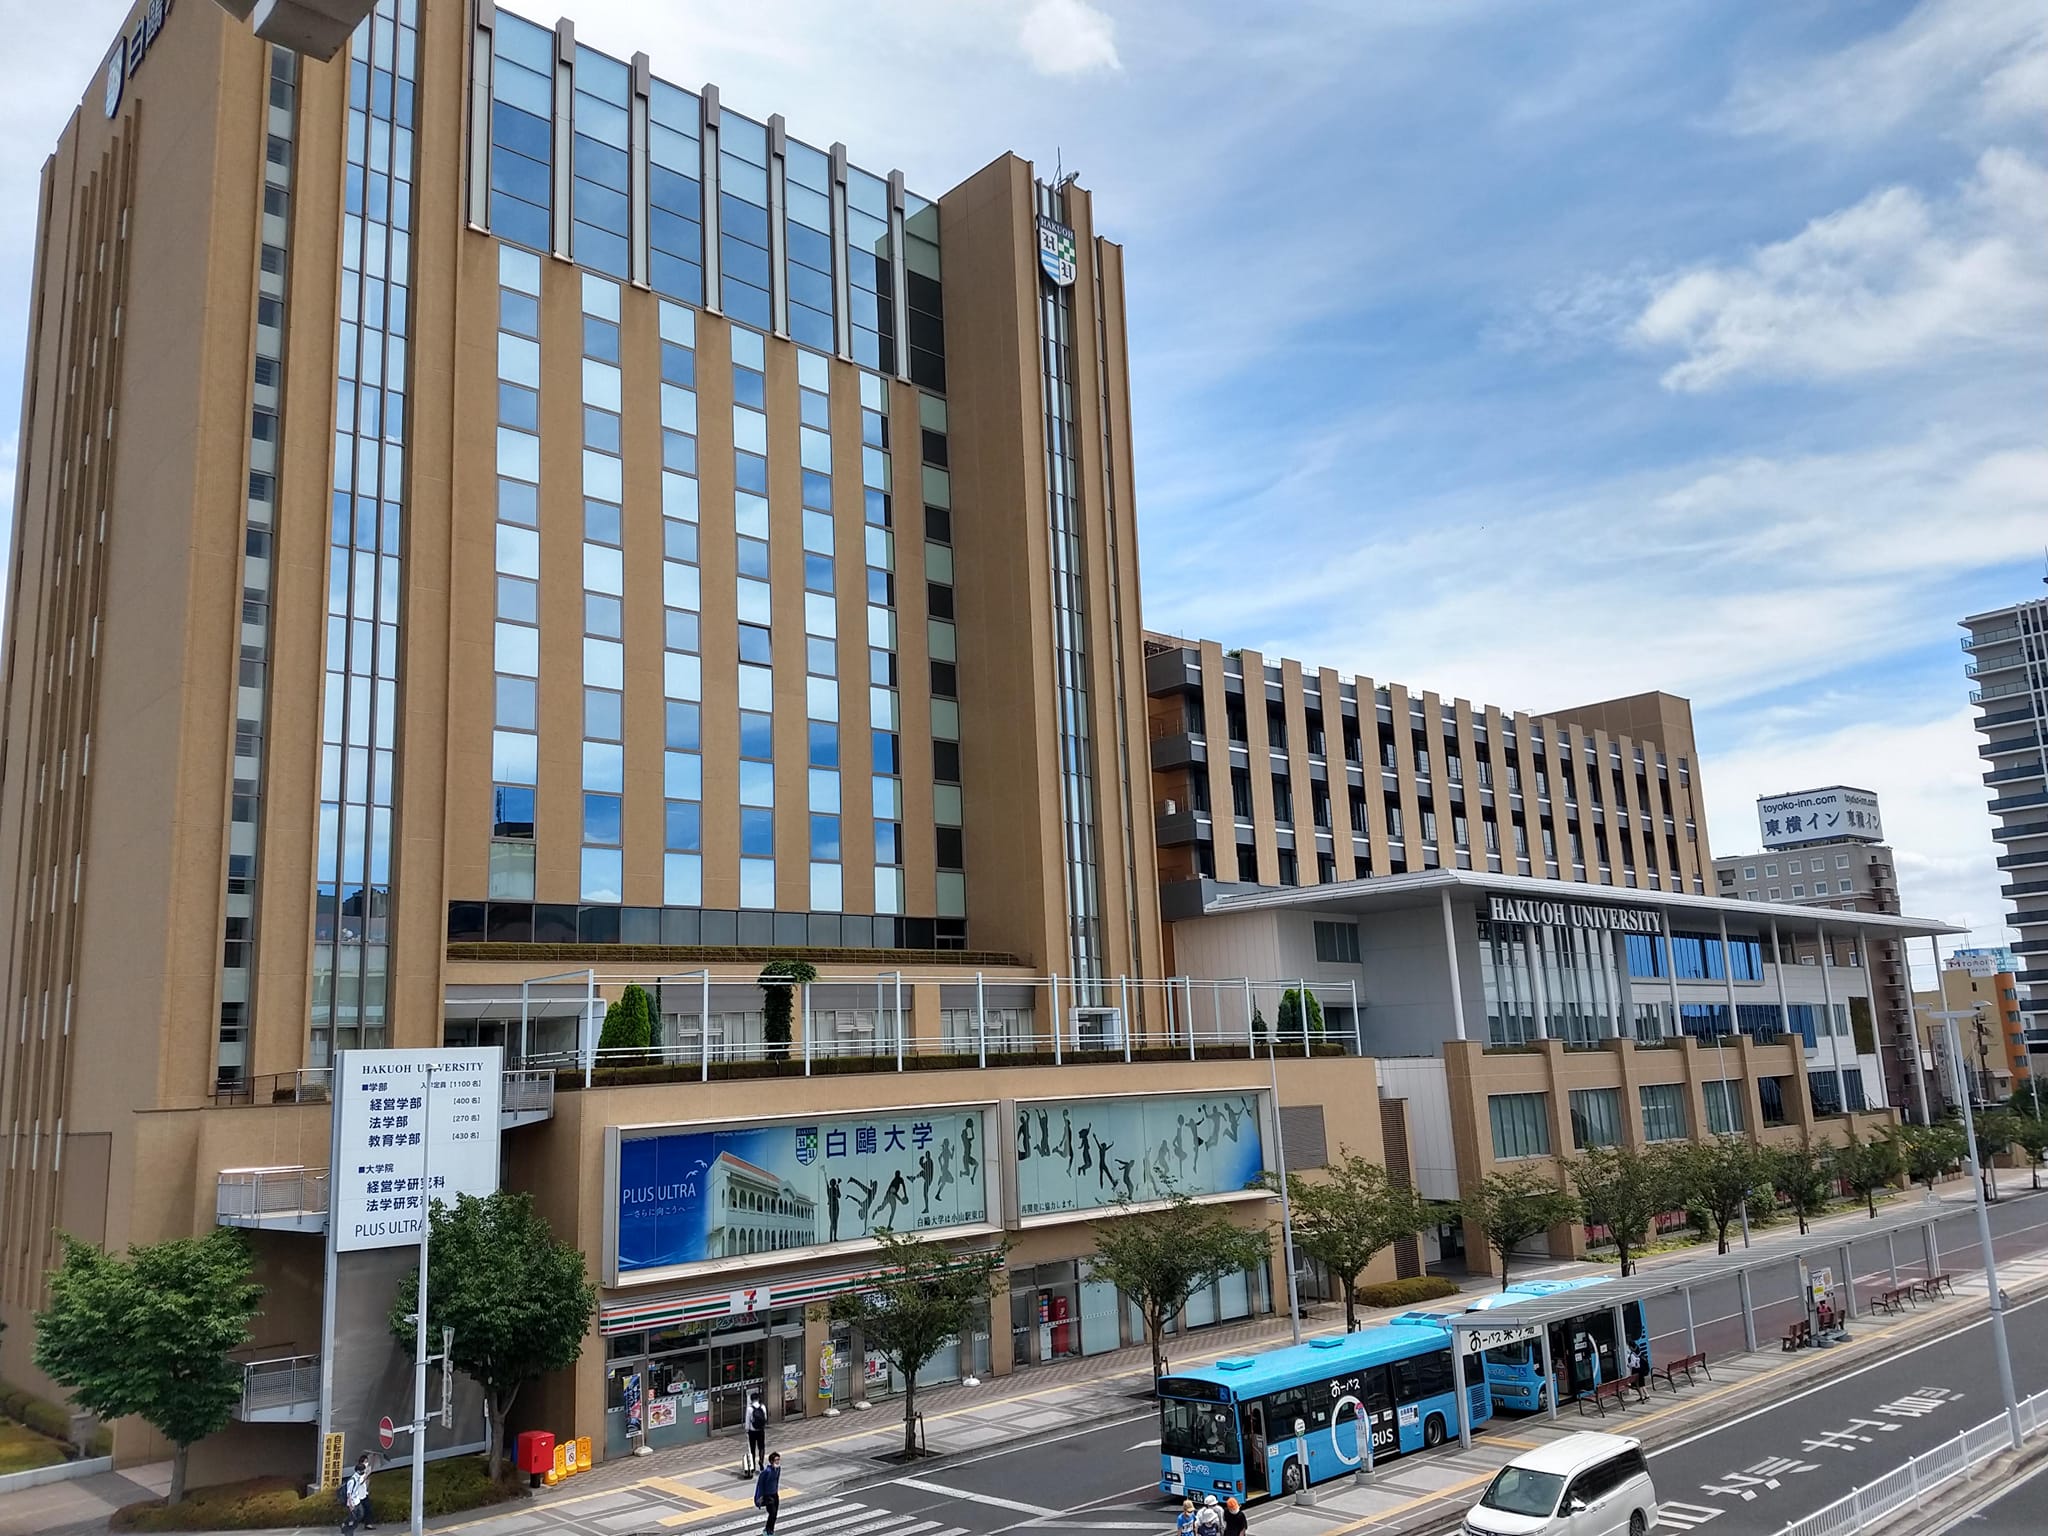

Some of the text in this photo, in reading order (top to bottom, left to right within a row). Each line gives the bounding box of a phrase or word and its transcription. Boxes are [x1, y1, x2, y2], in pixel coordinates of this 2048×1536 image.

[1040, 217, 1074, 240] HAKUOH
[1763, 795, 1837, 814] toyoko-inn.com
[1764, 811, 1840, 837] 東横イン
[1489, 897, 1661, 932] HAKUOH UNIVERSITY
[362, 1064, 412, 1074] HAKUOH
[420, 1081, 447, 1089] 入定員
[369, 1097, 422, 1112] 経営学部
[369, 1115, 408, 1129] 法学部
[368, 1133, 421, 1148] 教育学部
[365, 1163, 394, 1174] 大学院
[623, 1183, 697, 1204] PLUS ULTRA
[355, 1222, 385, 1237] PLUS
[1372, 1428, 1394, 1447] BUS
